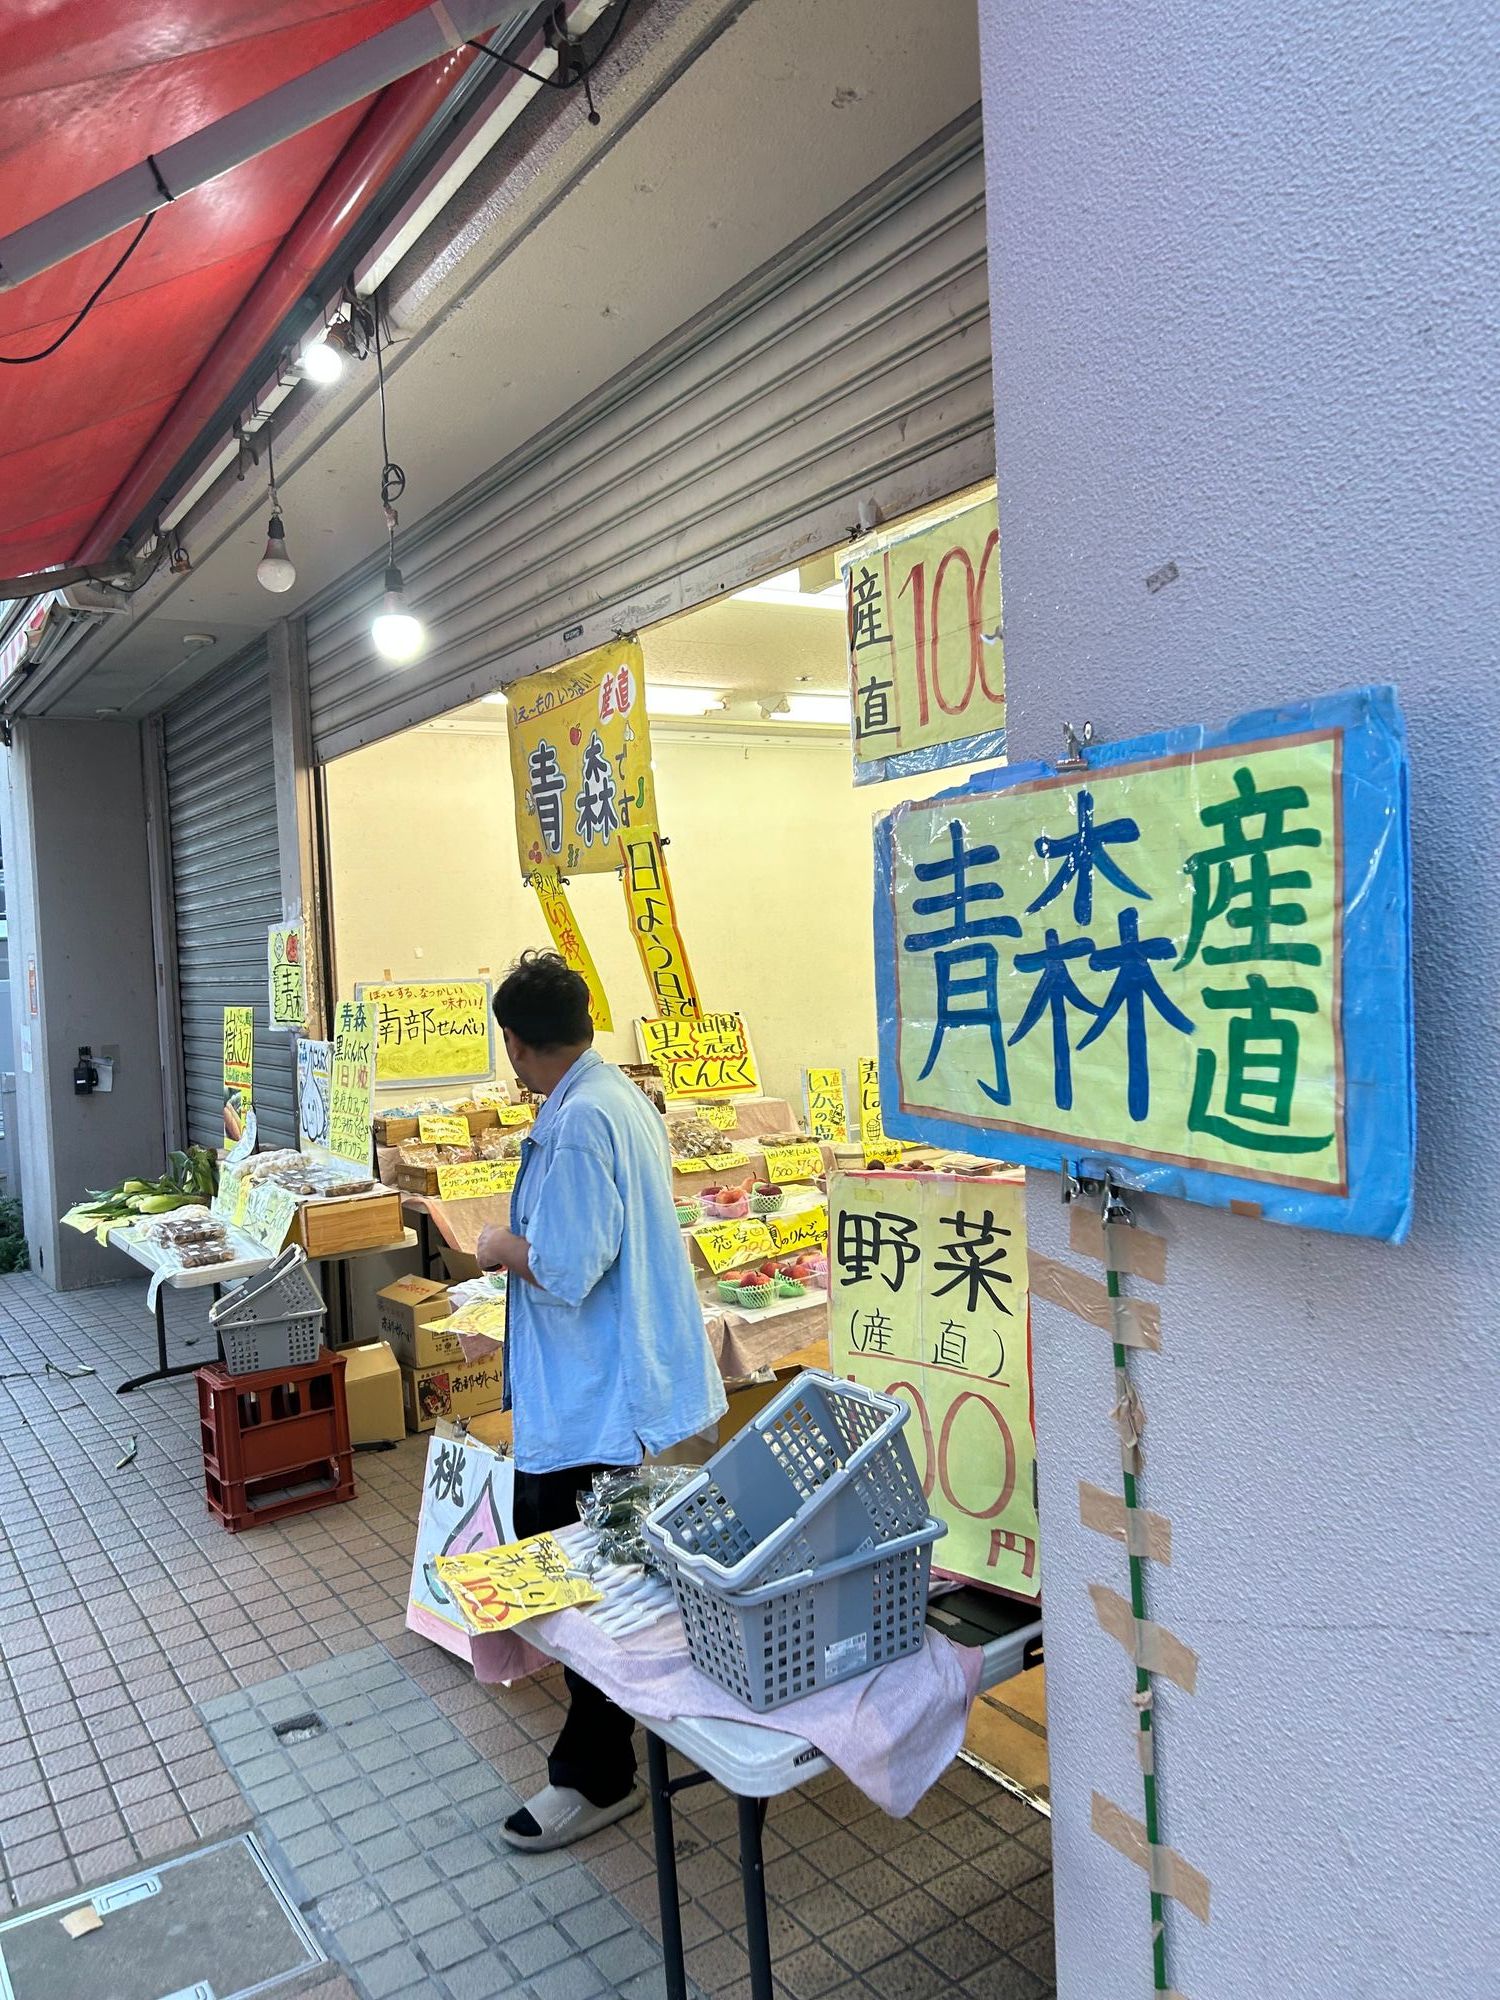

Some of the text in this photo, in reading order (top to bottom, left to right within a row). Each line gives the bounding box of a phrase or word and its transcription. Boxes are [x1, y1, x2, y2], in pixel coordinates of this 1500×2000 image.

[851, 566, 901, 740] 産直
[600, 667, 631, 720] 産直
[530, 732, 619, 852] 青森
[615, 743, 635, 828] です
[903, 791, 1196, 1122] 青森
[1172, 767, 1336, 1154] 産直
[341, 1002, 368, 1032] 青森
[378, 1003, 486, 1046] 南部せんべい
[671, 1057, 757, 1089] にんにく
[837, 1209, 1014, 1317] 野菜
[428, 1443, 467, 1508] 桃
[987, 1527, 1036, 1579] 円
